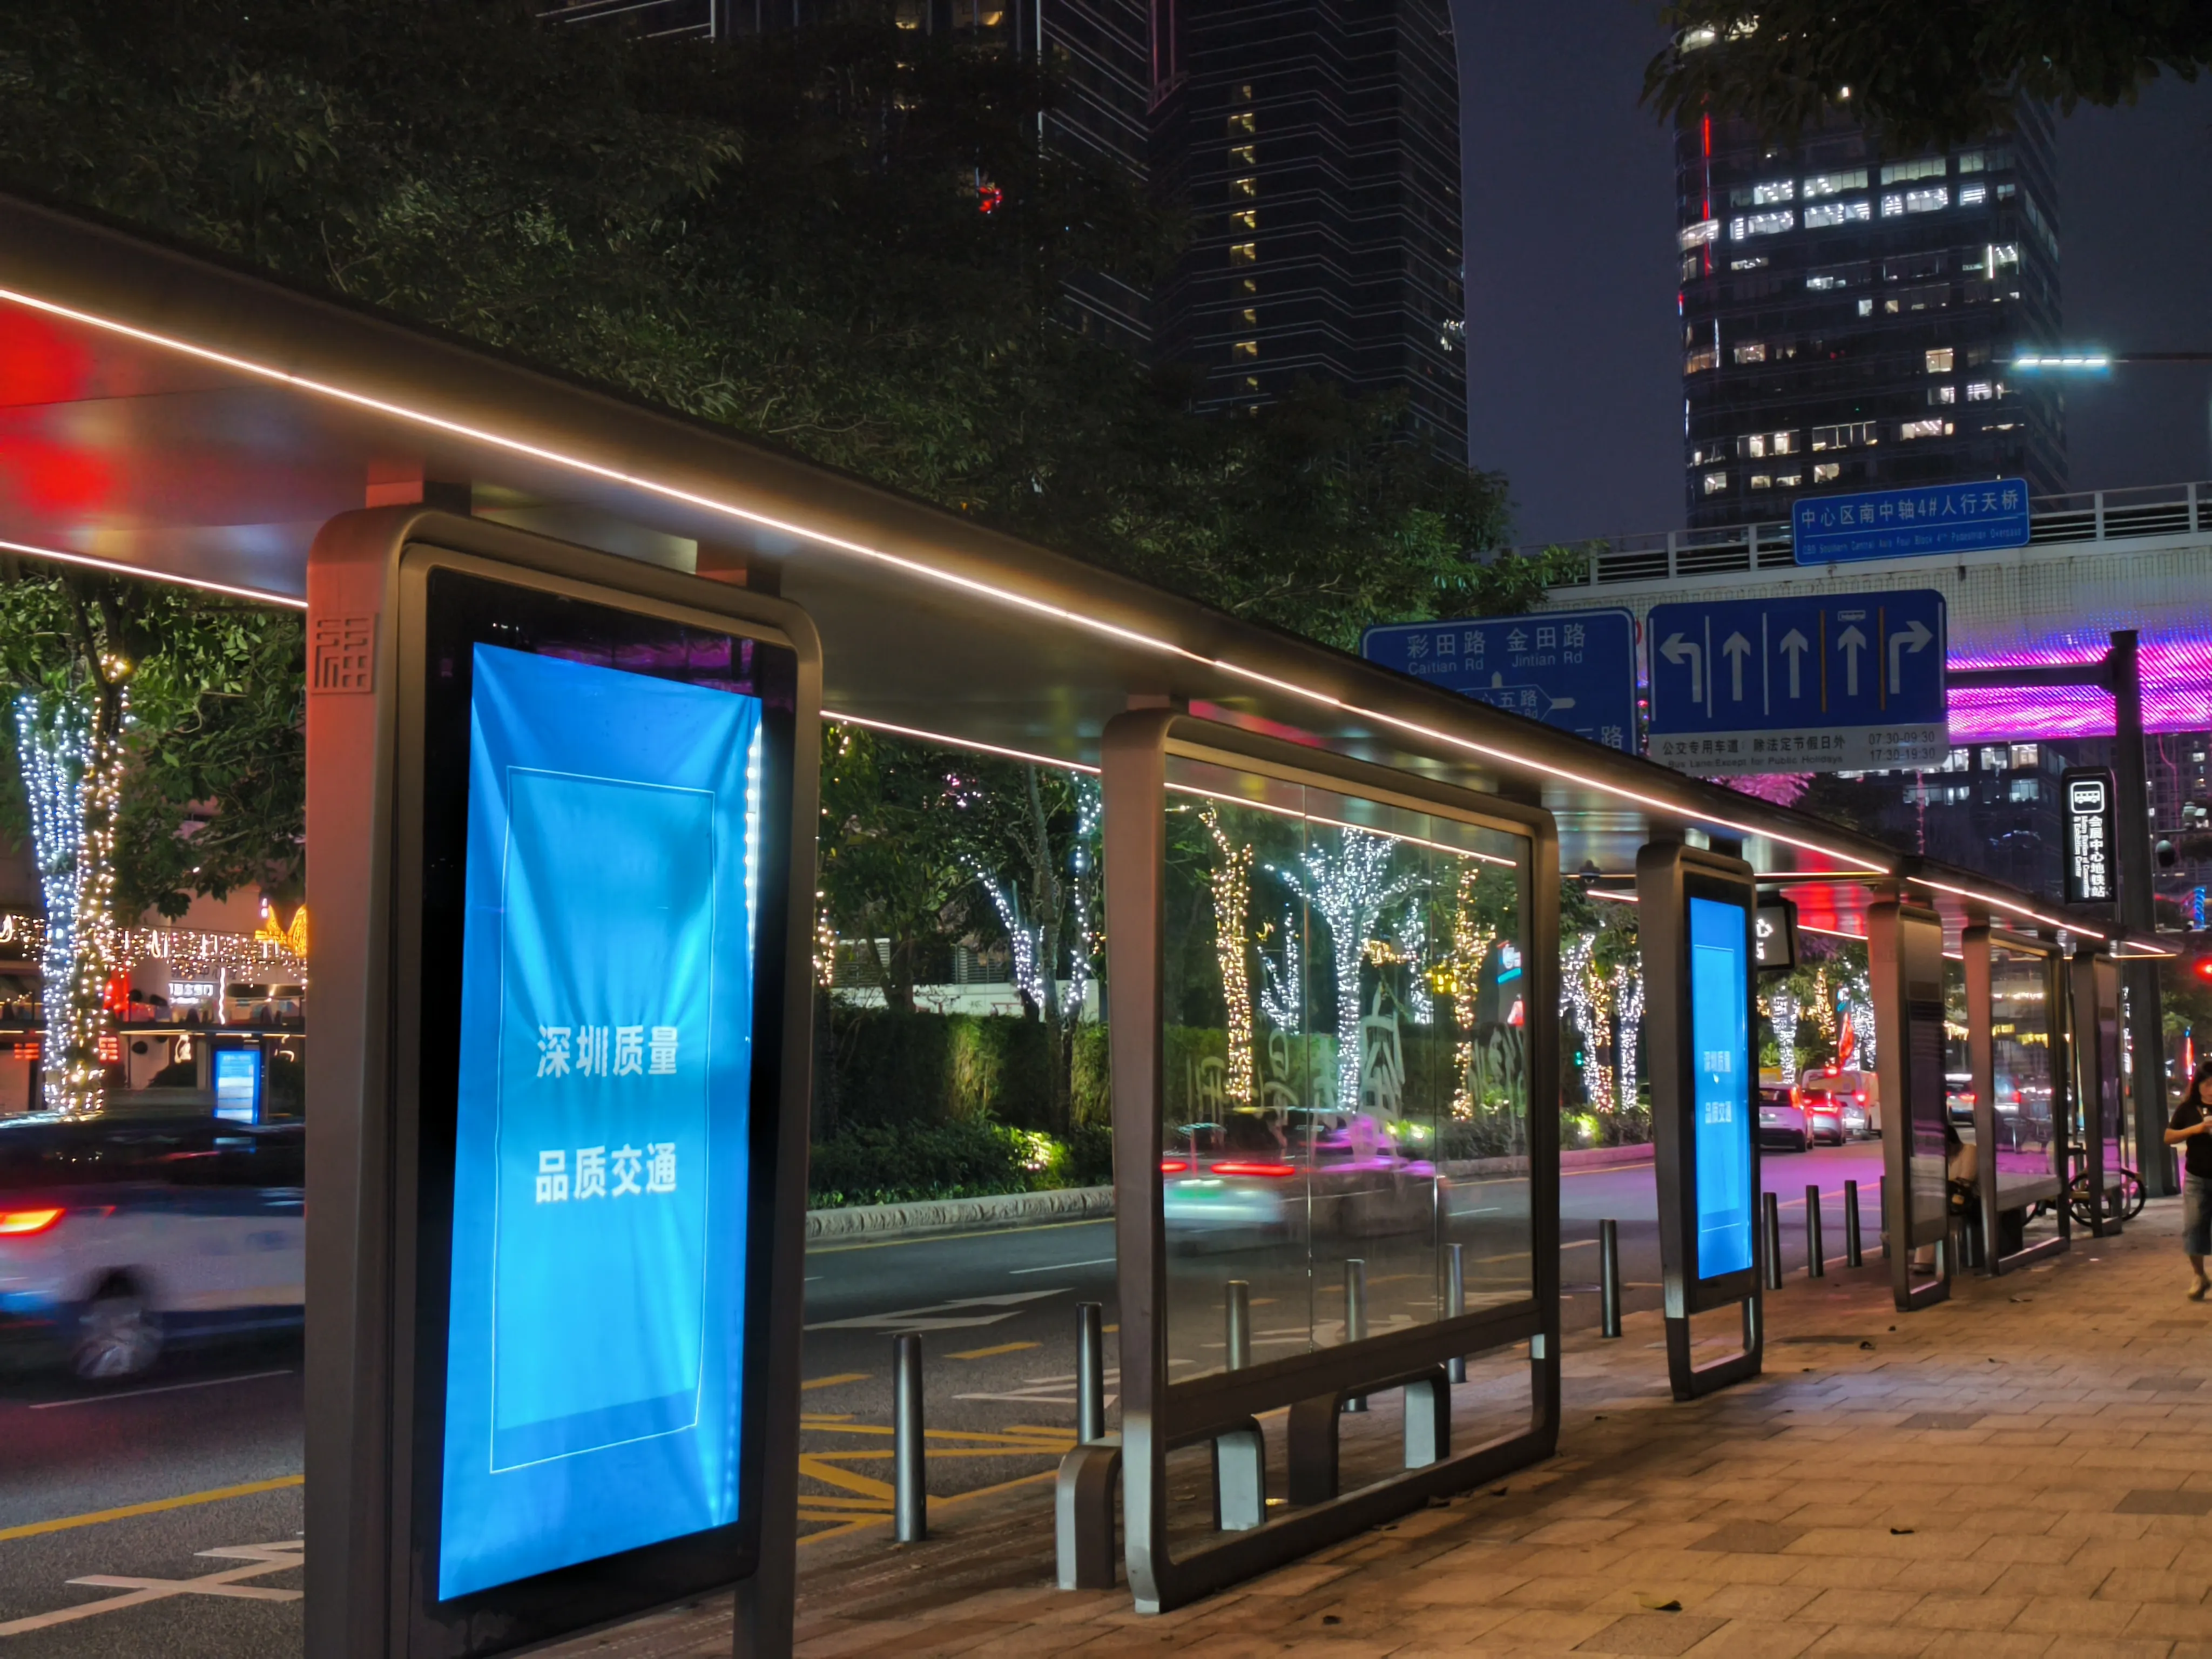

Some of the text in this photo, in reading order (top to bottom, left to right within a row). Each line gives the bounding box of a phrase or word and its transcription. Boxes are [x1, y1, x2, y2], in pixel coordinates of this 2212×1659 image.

[1802, 489, 2019, 529] 中心区南中轴4#人行天桥
[1407, 623, 1586, 658] 彩田路 金田路
[1512, 651, 1582, 667] Jintian Rd
[1408, 658, 1483, 675] Caitian Rd
[537, 1025, 678, 1078] 深圳质量
[536, 1143, 676, 1203] 品质交通
